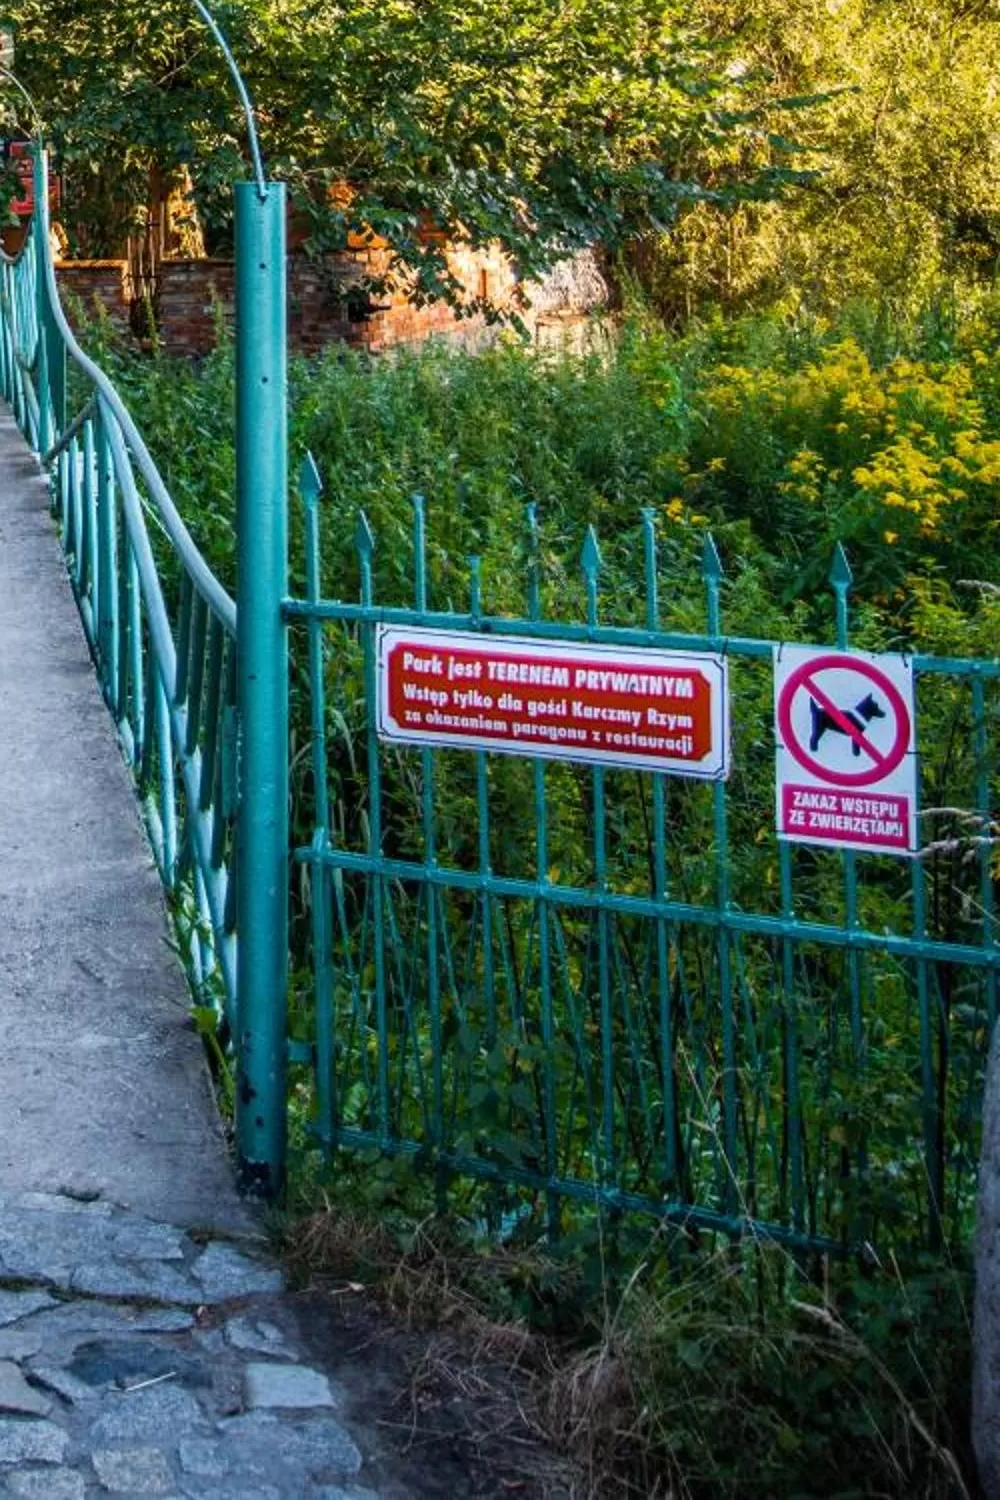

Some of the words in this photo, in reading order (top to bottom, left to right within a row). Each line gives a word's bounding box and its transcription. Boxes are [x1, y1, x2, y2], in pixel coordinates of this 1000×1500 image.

[403, 651, 443, 675] Park
[448, 655, 483, 681] jest
[487, 660, 570, 687] TERENEM
[575, 669, 694, 699] PRYWATNYM
[403, 682, 449, 707] Wstęp
[453, 689, 493, 709] tylko
[497, 693, 523, 711] dla
[527, 698, 567, 717] gości
[571, 701, 642, 728] Karczmy
[647, 707, 694, 731] Rzym
[404, 710, 422, 723] za
[425, 709, 508, 731] okazaniem
[511, 721, 588, 740] paragonu
[591, 731, 601, 742] z
[605, 731, 694, 756] restauracji
[789, 809, 805, 826] ZE
[809, 812, 904, 837] ZWIERZĘTAMI
[792, 791, 837, 811] ZAKAZ
[841, 797, 899, 819] WSTĘPU
